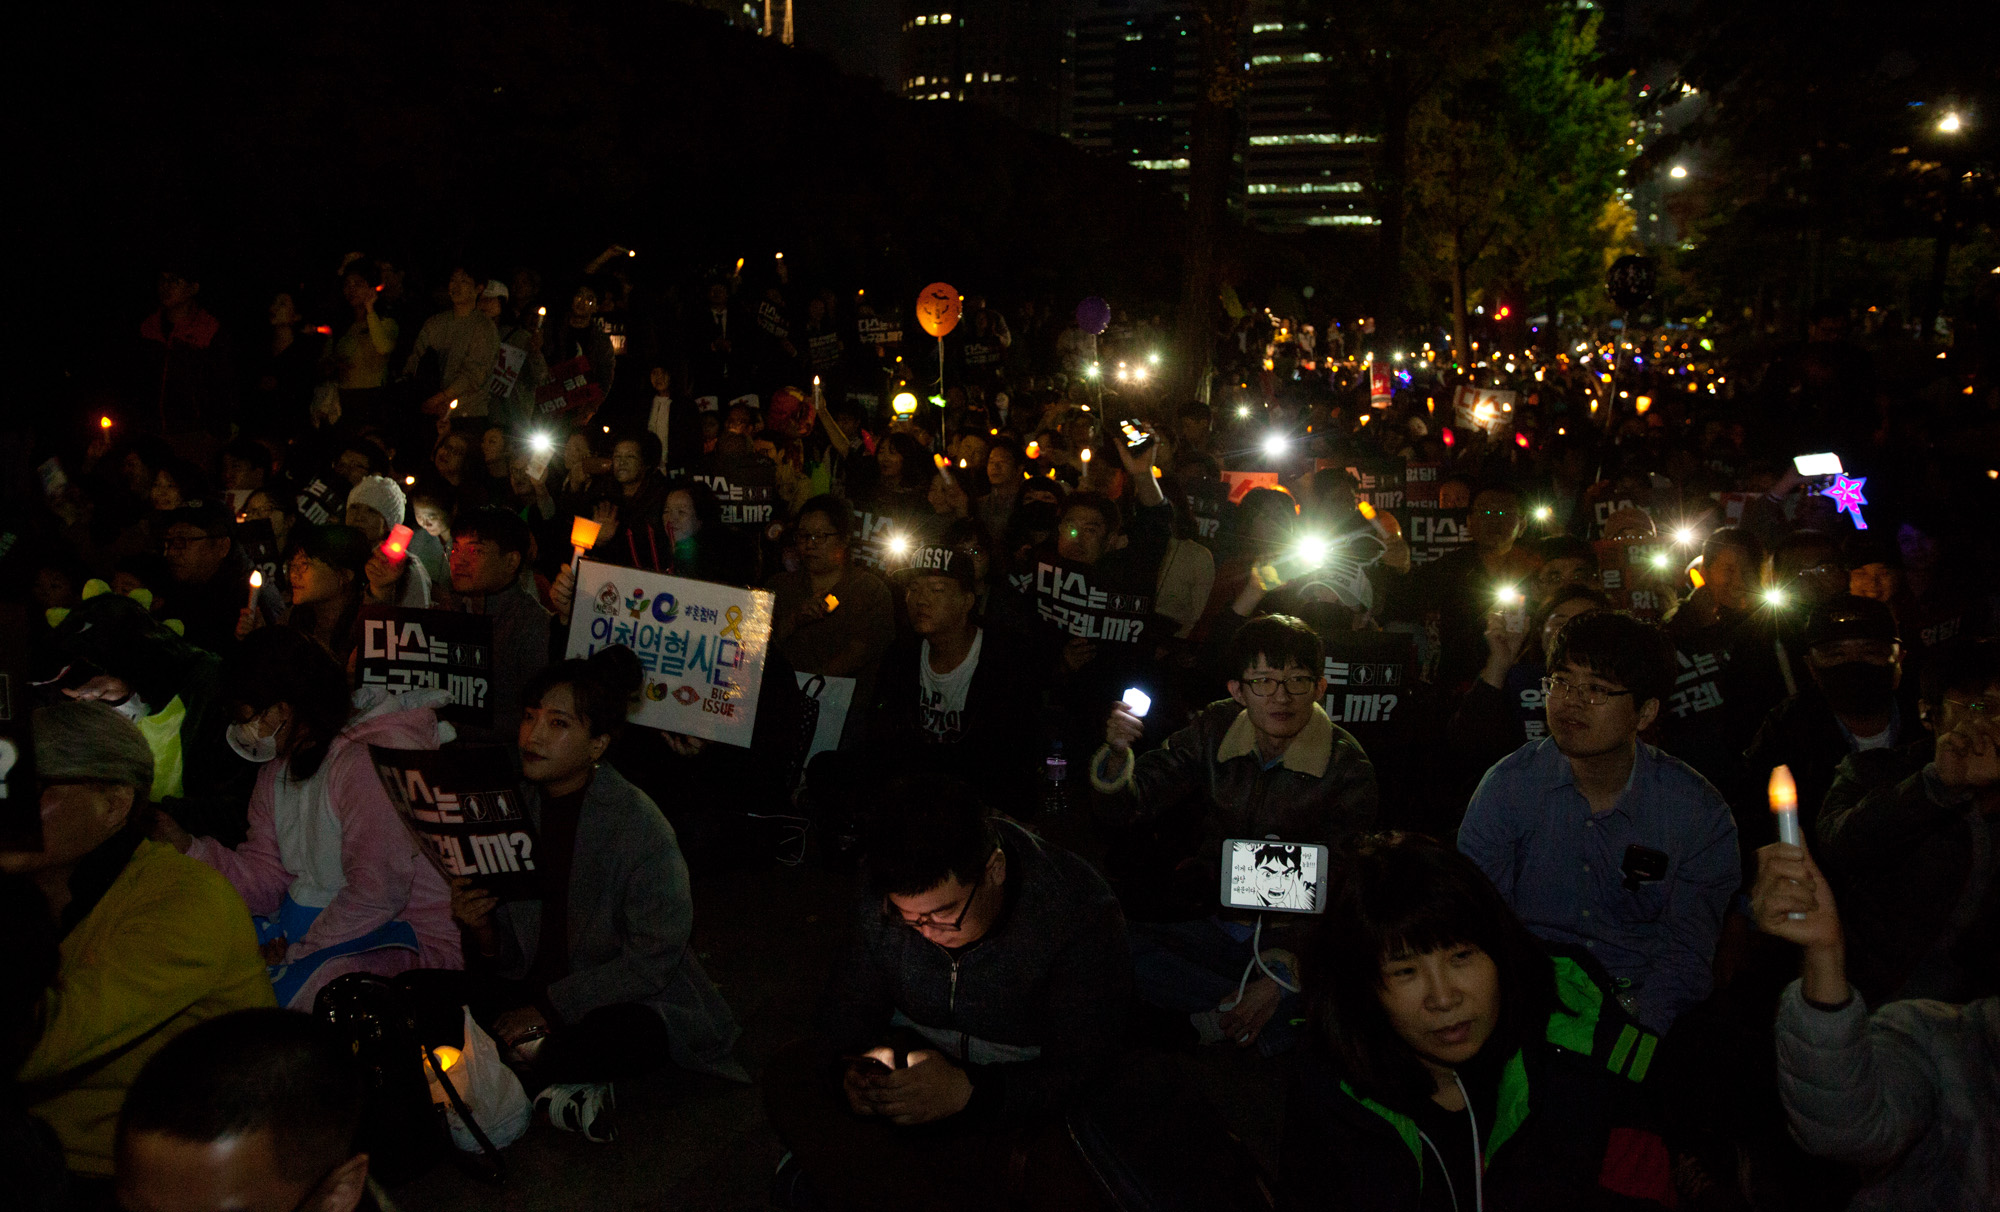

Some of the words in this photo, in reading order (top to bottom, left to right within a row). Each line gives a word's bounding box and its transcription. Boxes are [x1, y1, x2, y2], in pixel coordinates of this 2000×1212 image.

[721, 504, 772, 523] 겁니까?
[1037, 562, 1108, 609] 다스는
[1037, 598, 1144, 643] 누구겁니까?
[364, 619, 449, 665] 다스는
[702, 697, 735, 718] ISSUE
[712, 687, 731, 702] BIG
